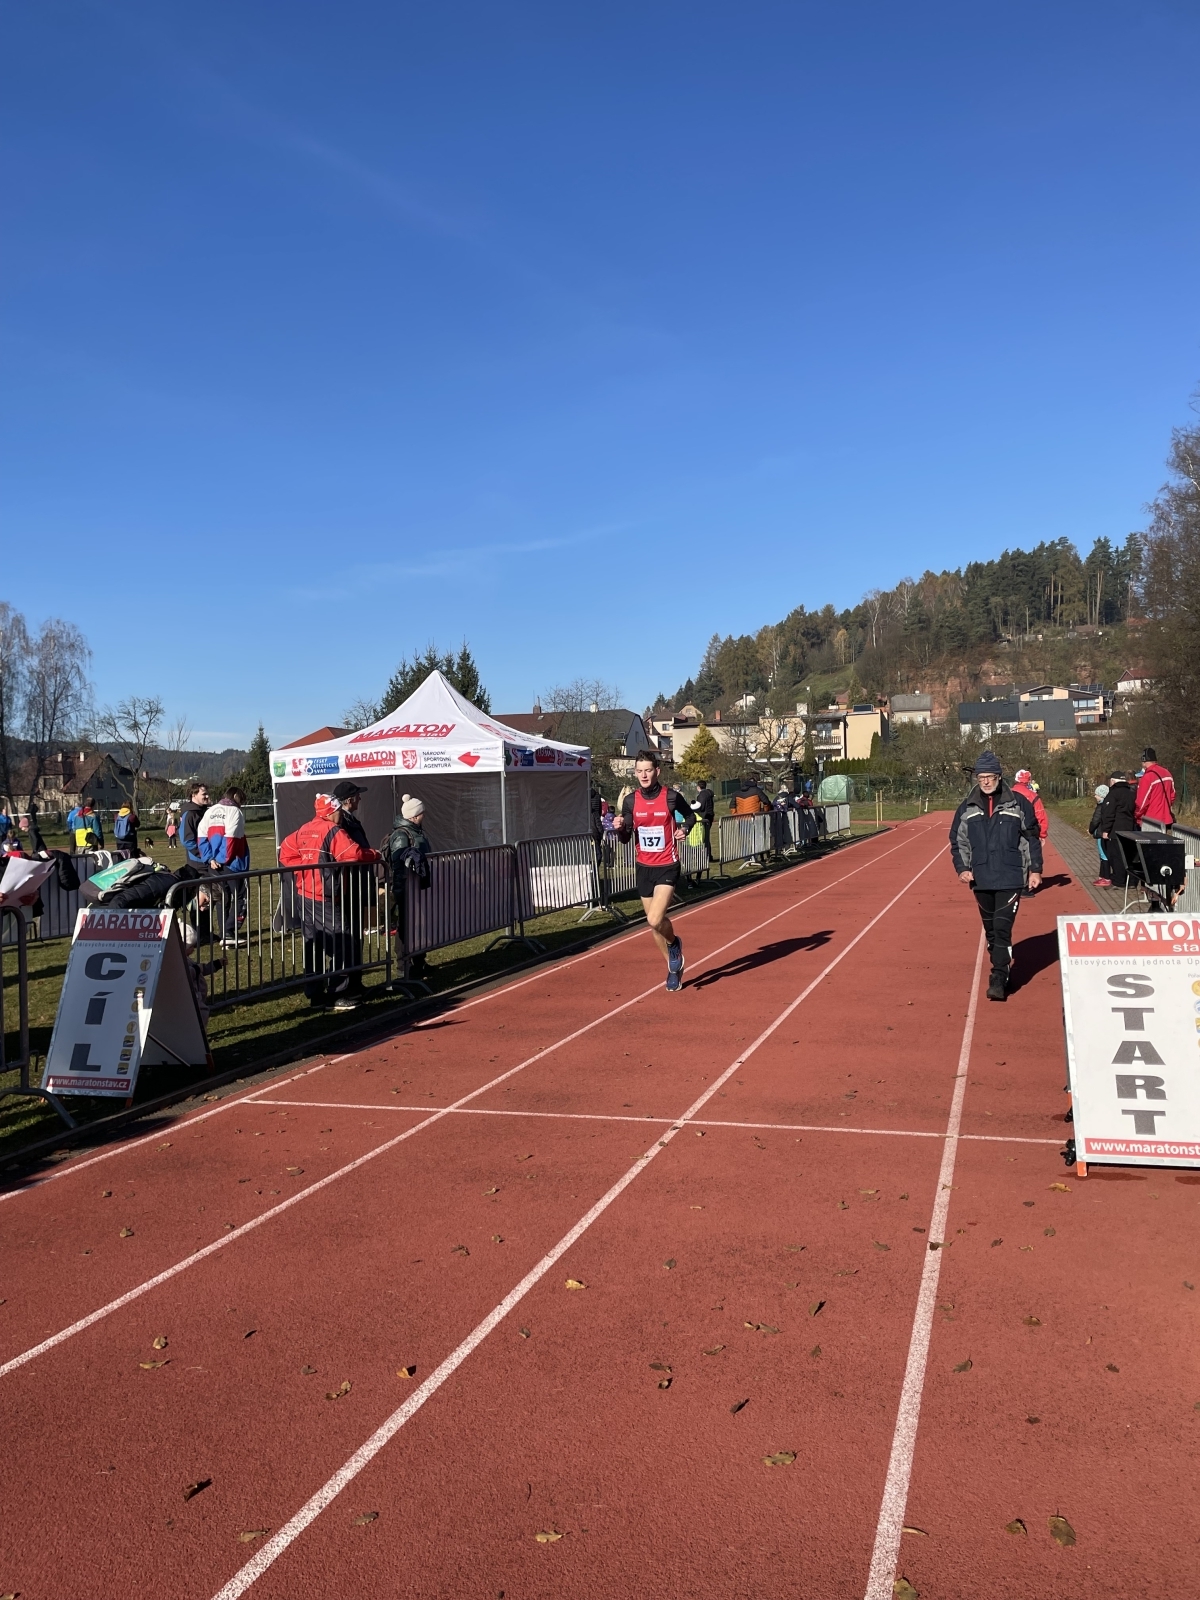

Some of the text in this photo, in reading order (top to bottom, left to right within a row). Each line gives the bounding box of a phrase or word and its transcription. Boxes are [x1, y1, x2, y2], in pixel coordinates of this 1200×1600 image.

[353, 724, 457, 740] MARATON
[345, 750, 395, 763] MARATON
[642, 837, 661, 847] 137
[80, 914, 167, 930] MARATON
[138, 931, 162, 939] stav
[1070, 958, 1138, 967] tělovýchovná
[1142, 958, 1182, 967] jednota
[68, 952, 128, 1073] CÍL
[1106, 974, 1168, 1135] START
